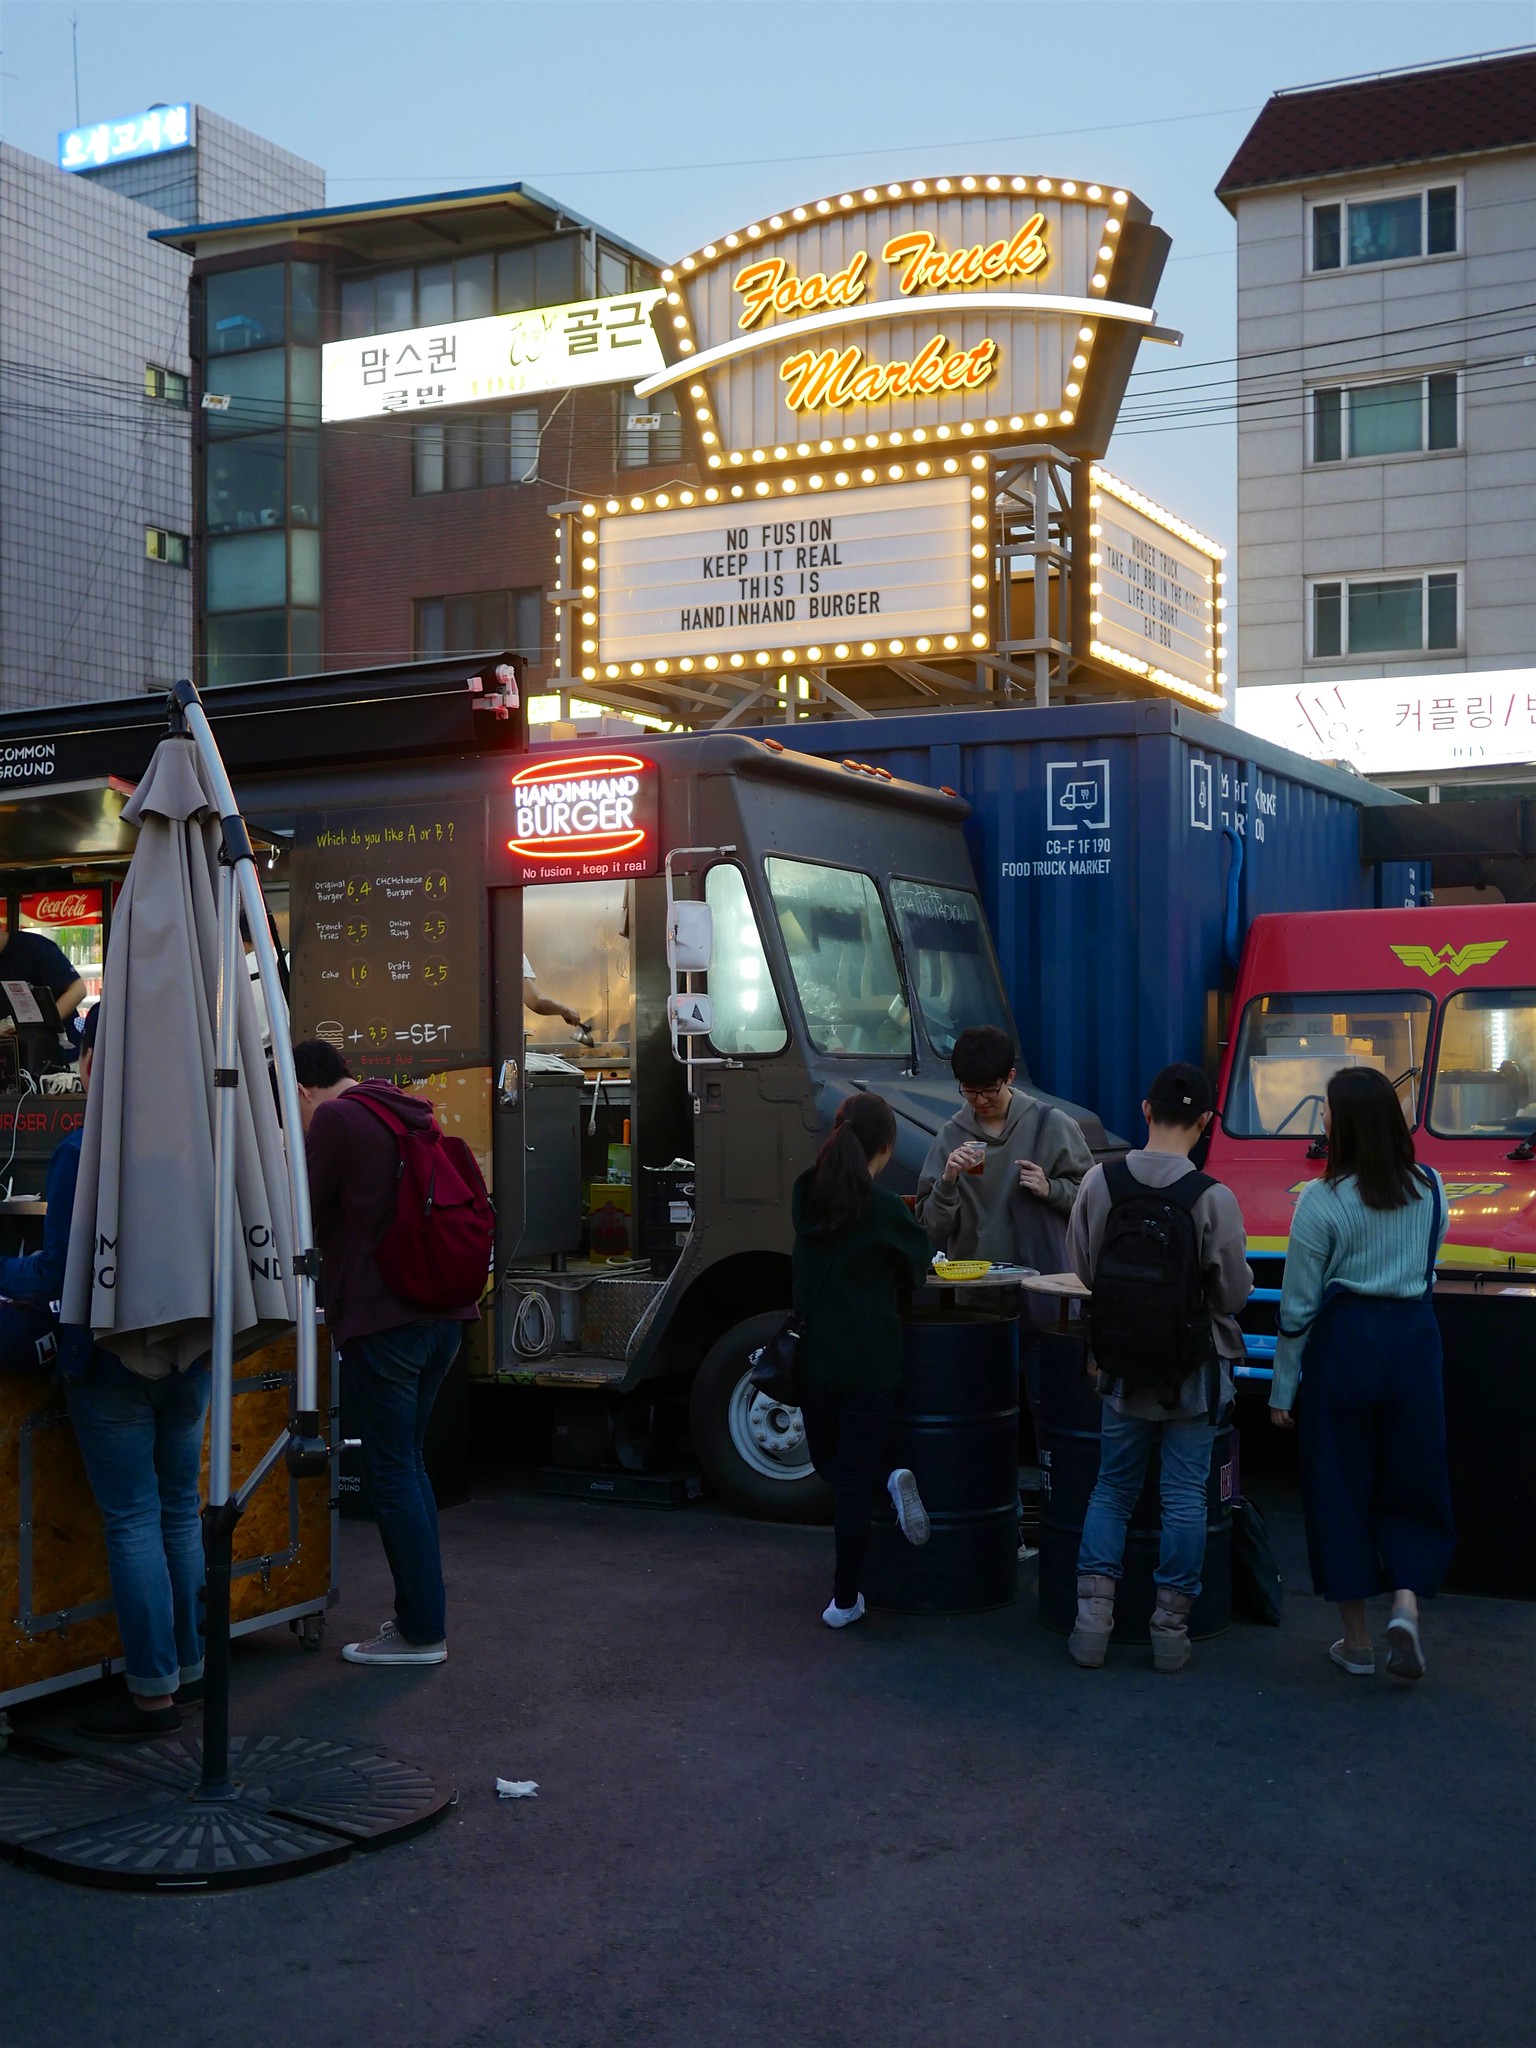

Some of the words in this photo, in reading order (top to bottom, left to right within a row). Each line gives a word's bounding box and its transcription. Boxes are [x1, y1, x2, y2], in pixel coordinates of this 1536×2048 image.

[732, 256, 868, 330] Food
[881, 212, 1047, 295] Truck
[361, 334, 457, 387] 맘스퀸
[563, 301, 654, 357] 골근
[779, 333, 999, 412] Market
[727, 528, 749, 551] NO
[762, 518, 832, 548] FUSION
[703, 553, 748, 579] KEEP
[764, 550, 783, 573] IT
[796, 543, 843, 569] REAL
[1107, 546, 1124, 575] TAKE
[739, 575, 784, 600] THIS
[801, 571, 820, 595] IS
[1128, 583, 1145, 611] LIFE
[1149, 594, 1156, 617] IS
[681, 598, 796, 631] HANDINHAND
[808, 591, 881, 619] BURGER
[1144, 616, 1157, 641] EAT
[514, 775, 639, 807] HANDINHAND
[516, 796, 634, 838] BURGER
[316, 829, 347, 848] Which
[351, 828, 361, 845] do
[364, 834, 381, 849] you
[384, 828, 404, 842] like
[408, 824, 417, 843] A
[420, 828, 431, 841] or
[435, 823, 443, 841] B
[1046, 839, 1075, 855] CG-F
[523, 868, 537, 879] No
[540, 866, 572, 878] fusion
[583, 863, 609, 876] keep
[612, 861, 620, 872] it
[624, 859, 646, 871] real
[1002, 861, 1031, 877] FOOD
[1033, 860, 1067, 876] TRUCK
[1069, 859, 1111, 875] MARKET
[315, 879, 346, 892] Original
[386, 888, 414, 900] Burger
[317, 891, 344, 904] Burger
[316, 921, 344, 931] French
[389, 920, 411, 928] Onion
[390, 929, 410, 940] Ring
[321, 970, 340, 979] Coke
[387, 960, 412, 971] Draft
[391, 970, 411, 981] Beer
[395, 1053, 413, 1065] Add
[0, 1113, 48, 1131] RGER
